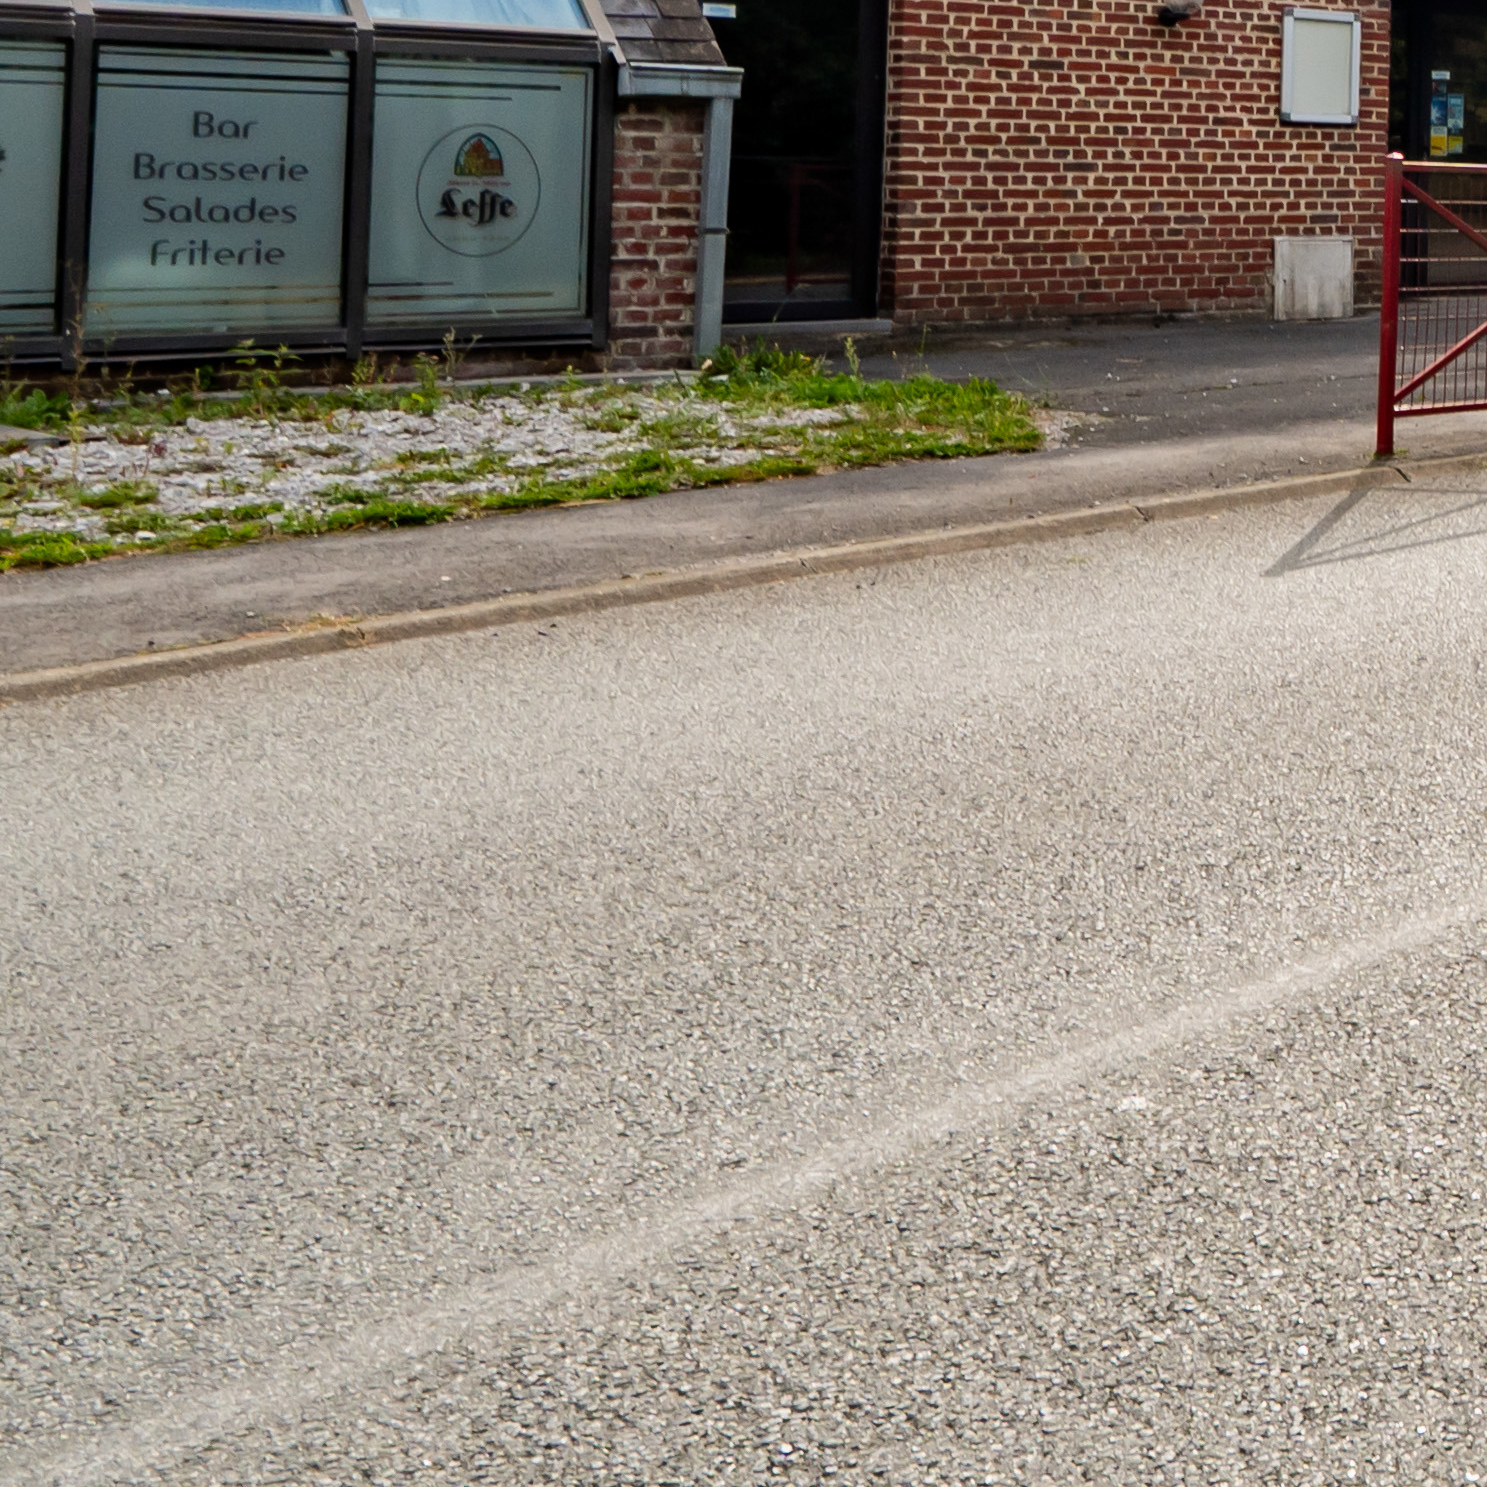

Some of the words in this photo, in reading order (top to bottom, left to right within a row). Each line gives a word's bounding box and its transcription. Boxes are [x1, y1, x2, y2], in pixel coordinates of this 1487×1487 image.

[192, 110, 258, 139] Bar
[133, 152, 309, 182] Brasserie
[142, 196, 297, 224] Salades
[435, 188, 518, 227] Leffe
